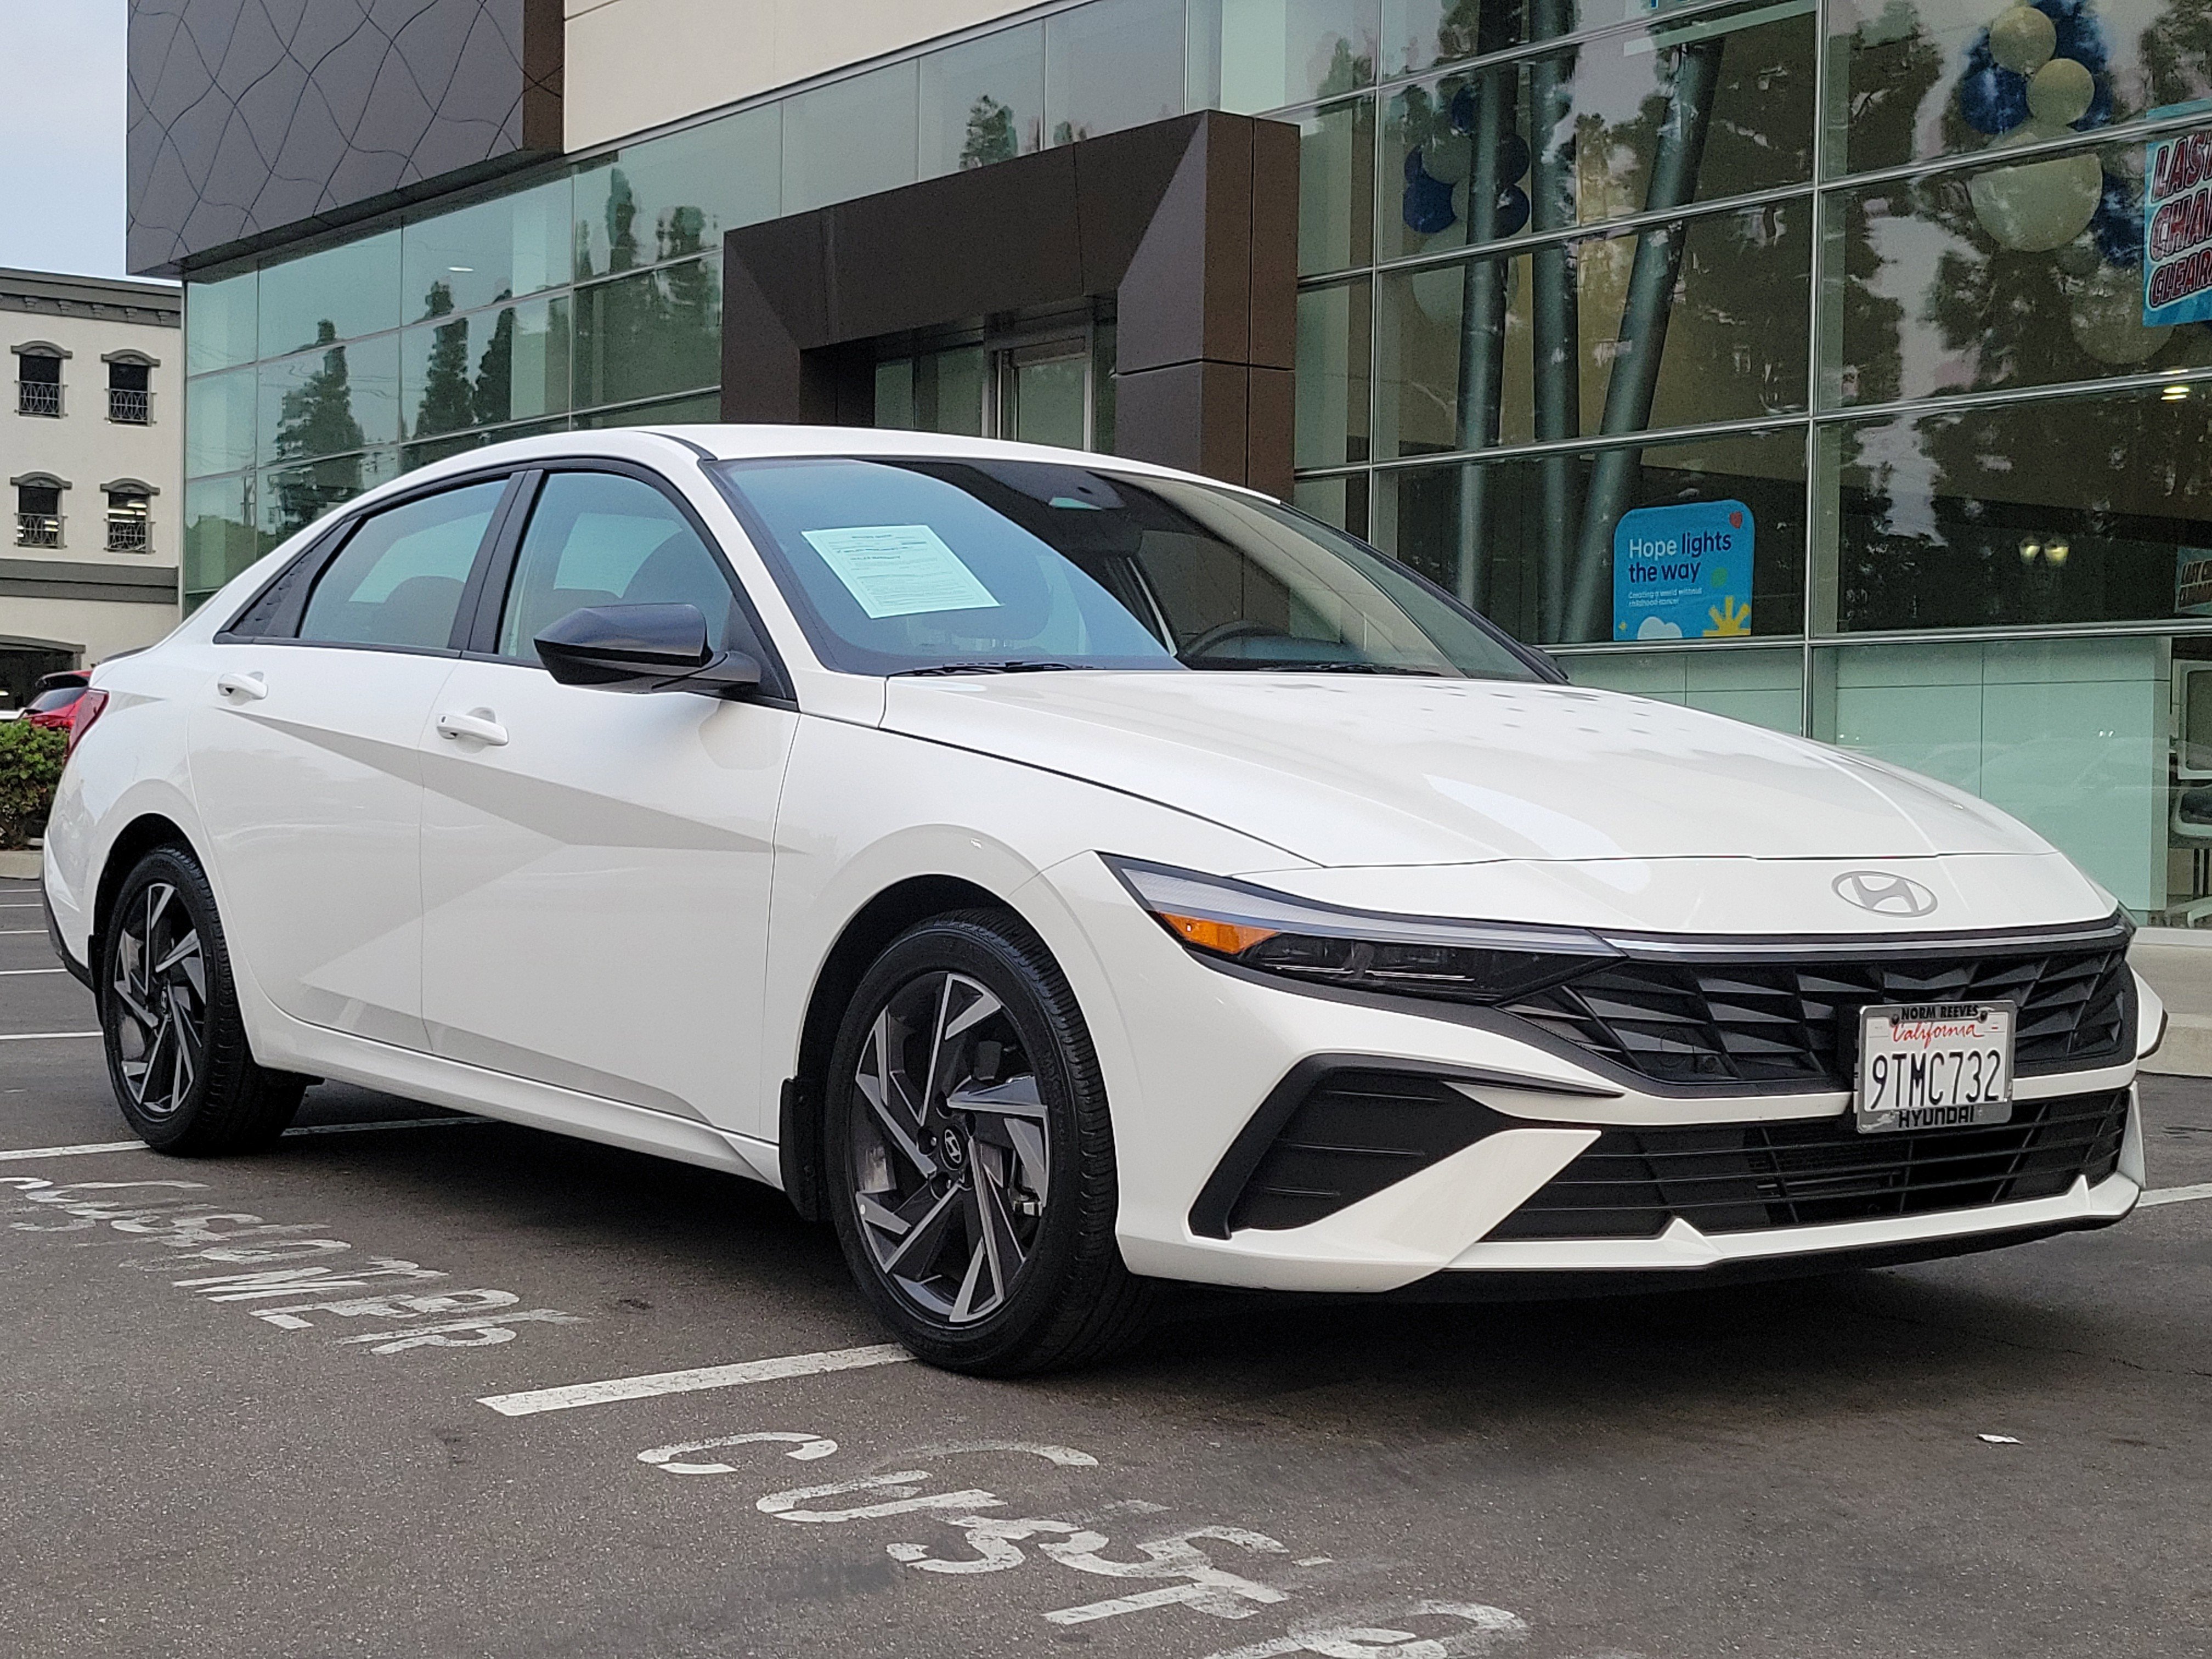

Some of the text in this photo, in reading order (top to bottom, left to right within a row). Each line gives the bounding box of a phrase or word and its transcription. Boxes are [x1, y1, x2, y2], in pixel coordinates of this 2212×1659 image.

[1629, 532, 1731, 560] Hope lights
[1628, 562, 1701, 583] the way
[1901, 1005, 1978, 1020] NORM REEVES
[1892, 1022, 1985, 1049] California
[1870, 1049, 2001, 1109] 9TMC732
[1899, 1106, 1974, 1128] HYUNDAI
